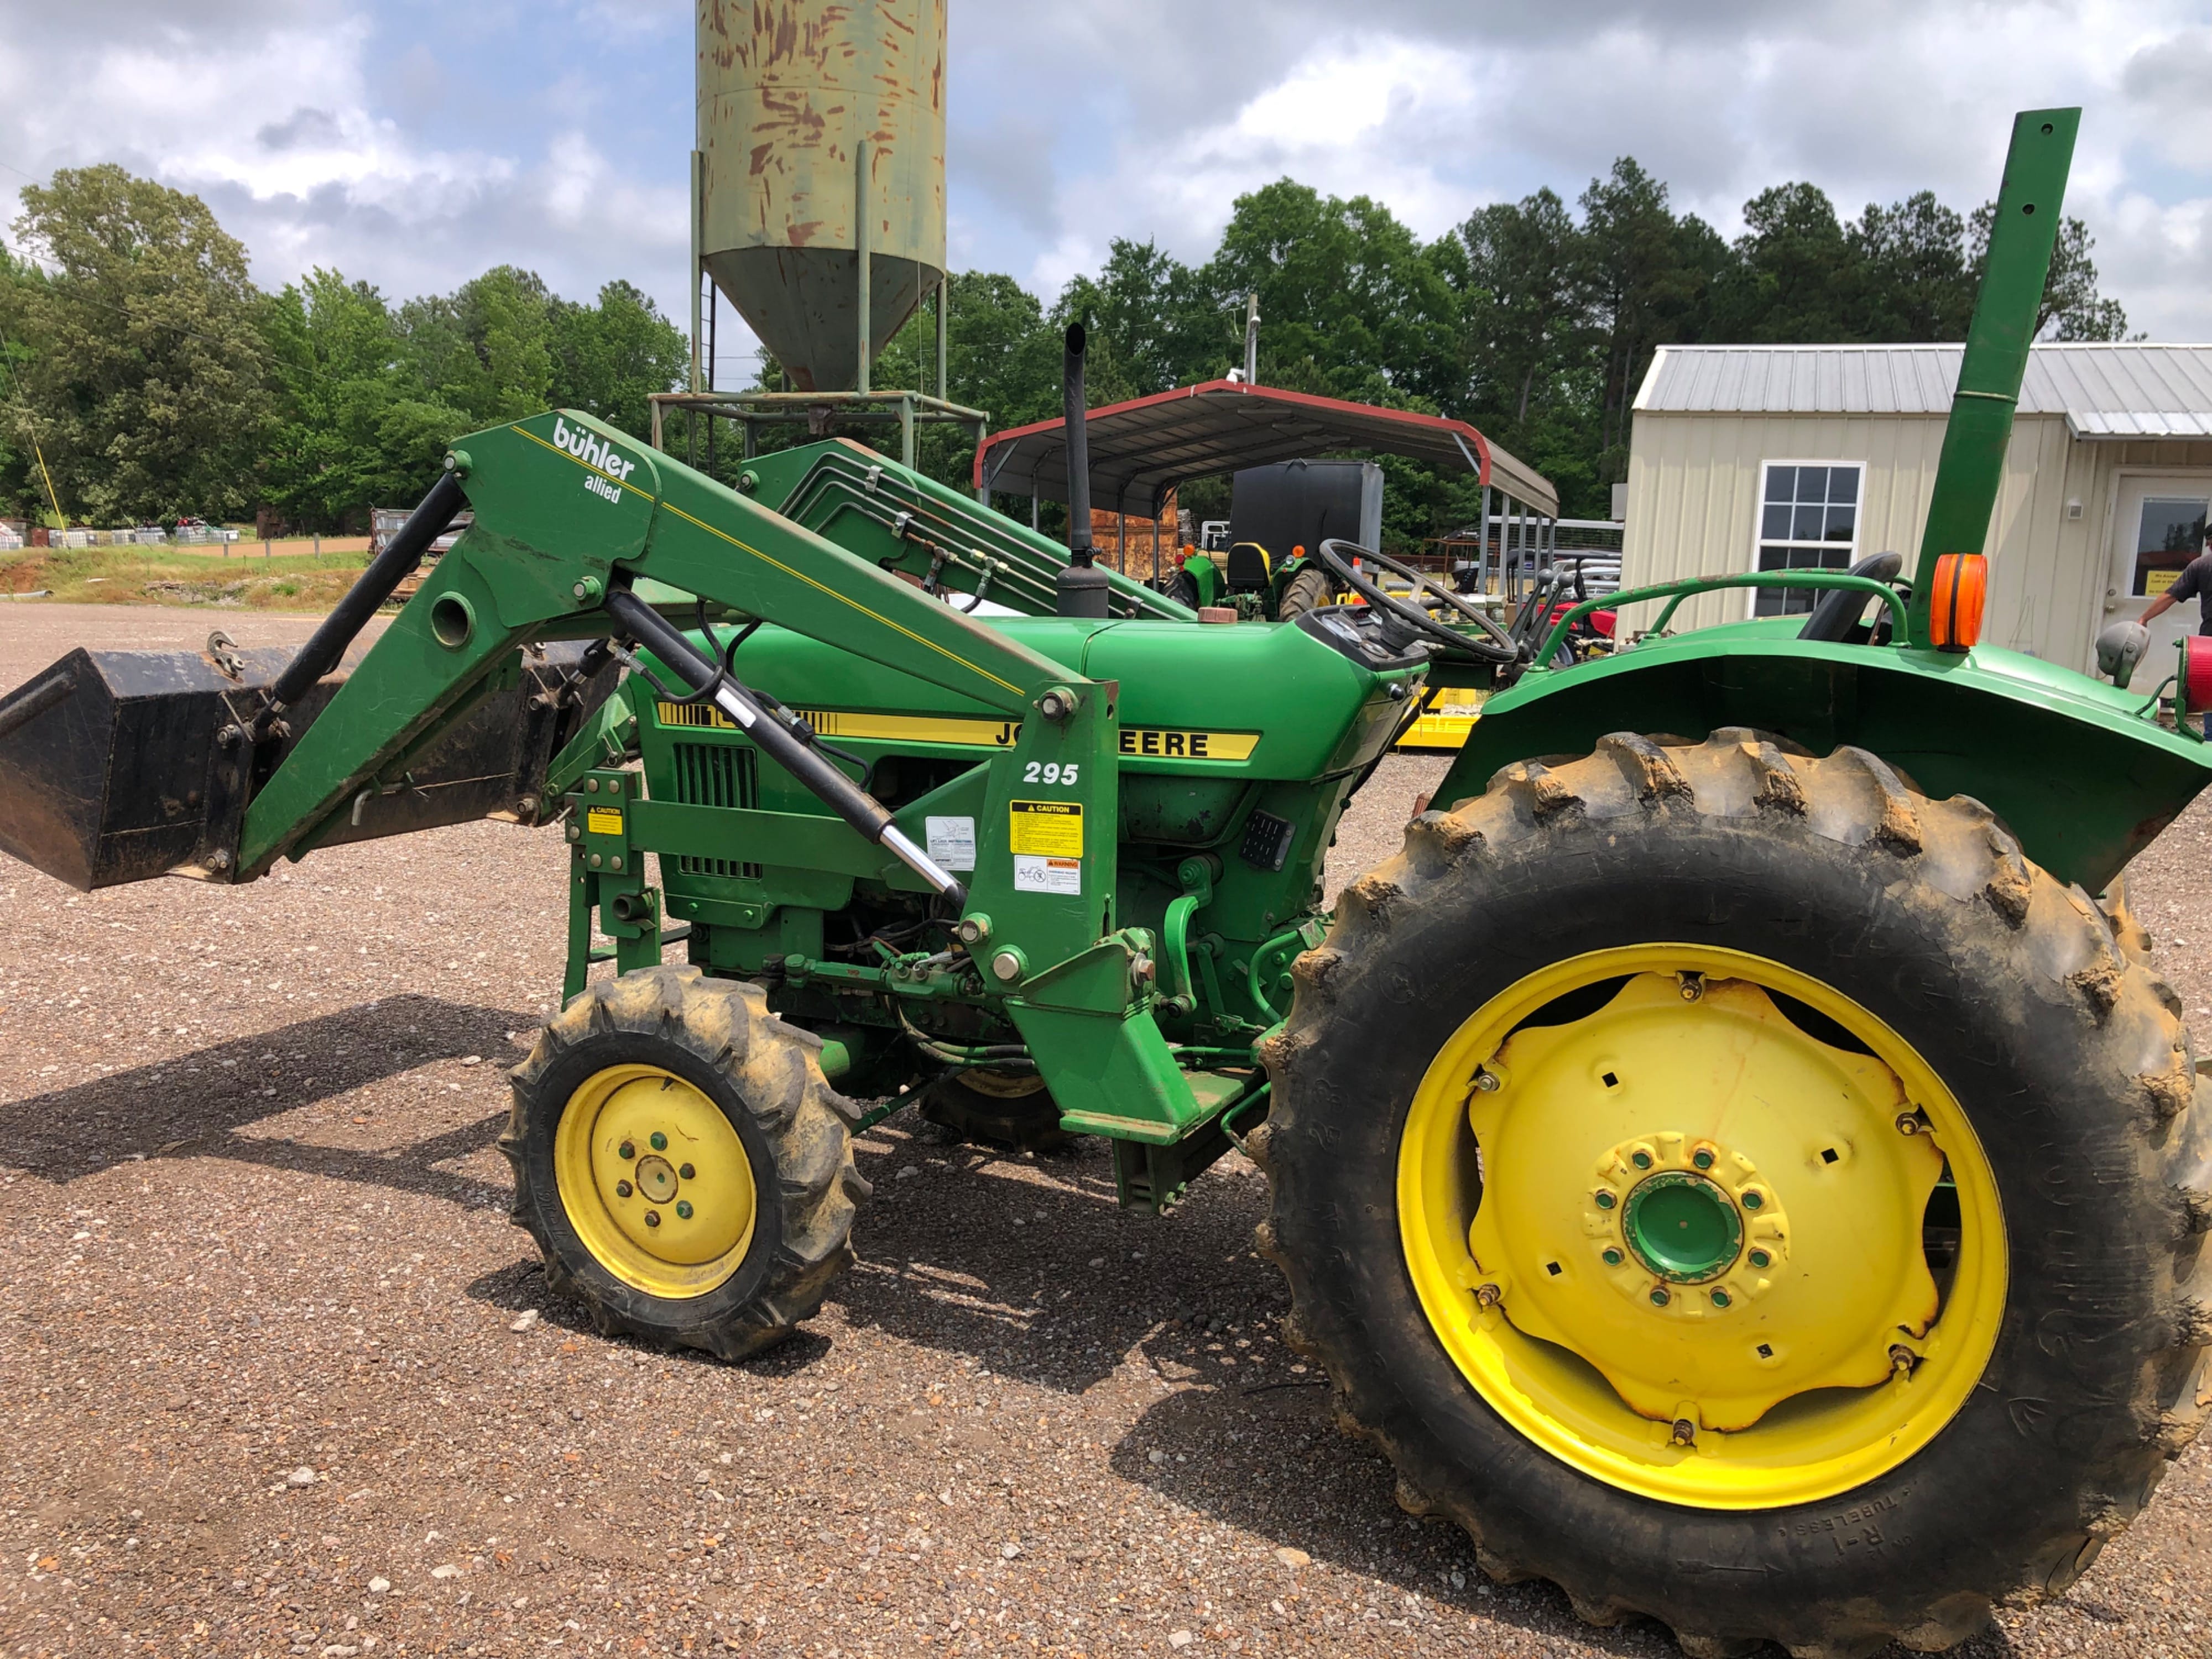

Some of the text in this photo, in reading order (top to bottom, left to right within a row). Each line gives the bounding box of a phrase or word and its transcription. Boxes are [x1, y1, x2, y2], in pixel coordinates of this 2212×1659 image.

[553, 418, 635, 481] bühler
[585, 475, 622, 504] allied
[1120, 731, 1208, 757] EERE
[1023, 761, 1079, 785] 295
[1036, 805, 1070, 813] CAUTION
[1795, 1495, 1898, 1537] TUBELESS
[1832, 1524, 1885, 1557] R-1
